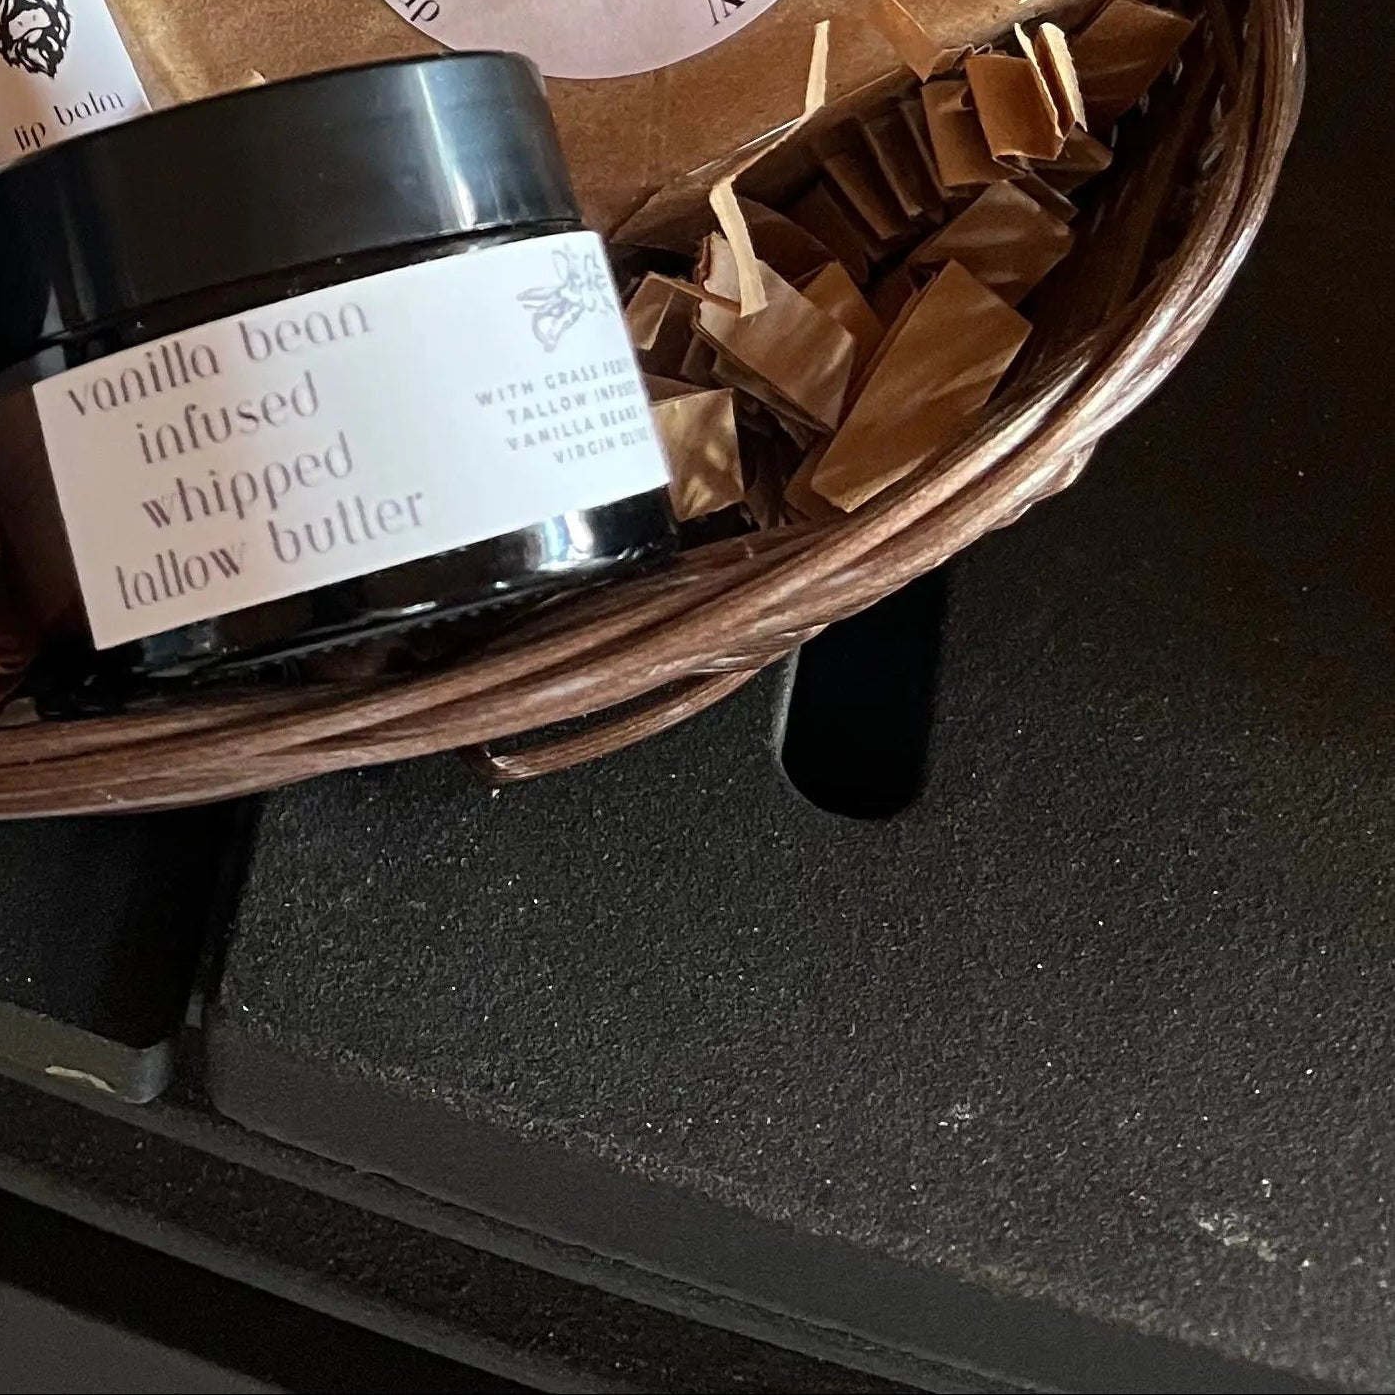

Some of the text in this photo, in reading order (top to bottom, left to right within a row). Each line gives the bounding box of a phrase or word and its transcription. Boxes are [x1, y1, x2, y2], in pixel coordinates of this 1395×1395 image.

[14, 91, 126, 152] lip balm
[67, 300, 372, 418] vanilla bean
[136, 369, 321, 466] infused
[475, 380, 534, 406] WITH
[507, 393, 586, 424] TALLOW
[506, 417, 594, 450] VANILLA
[553, 436, 616, 464] VIRGIN
[141, 430, 354, 531] whipped
[115, 489, 425, 611] tallow butter
